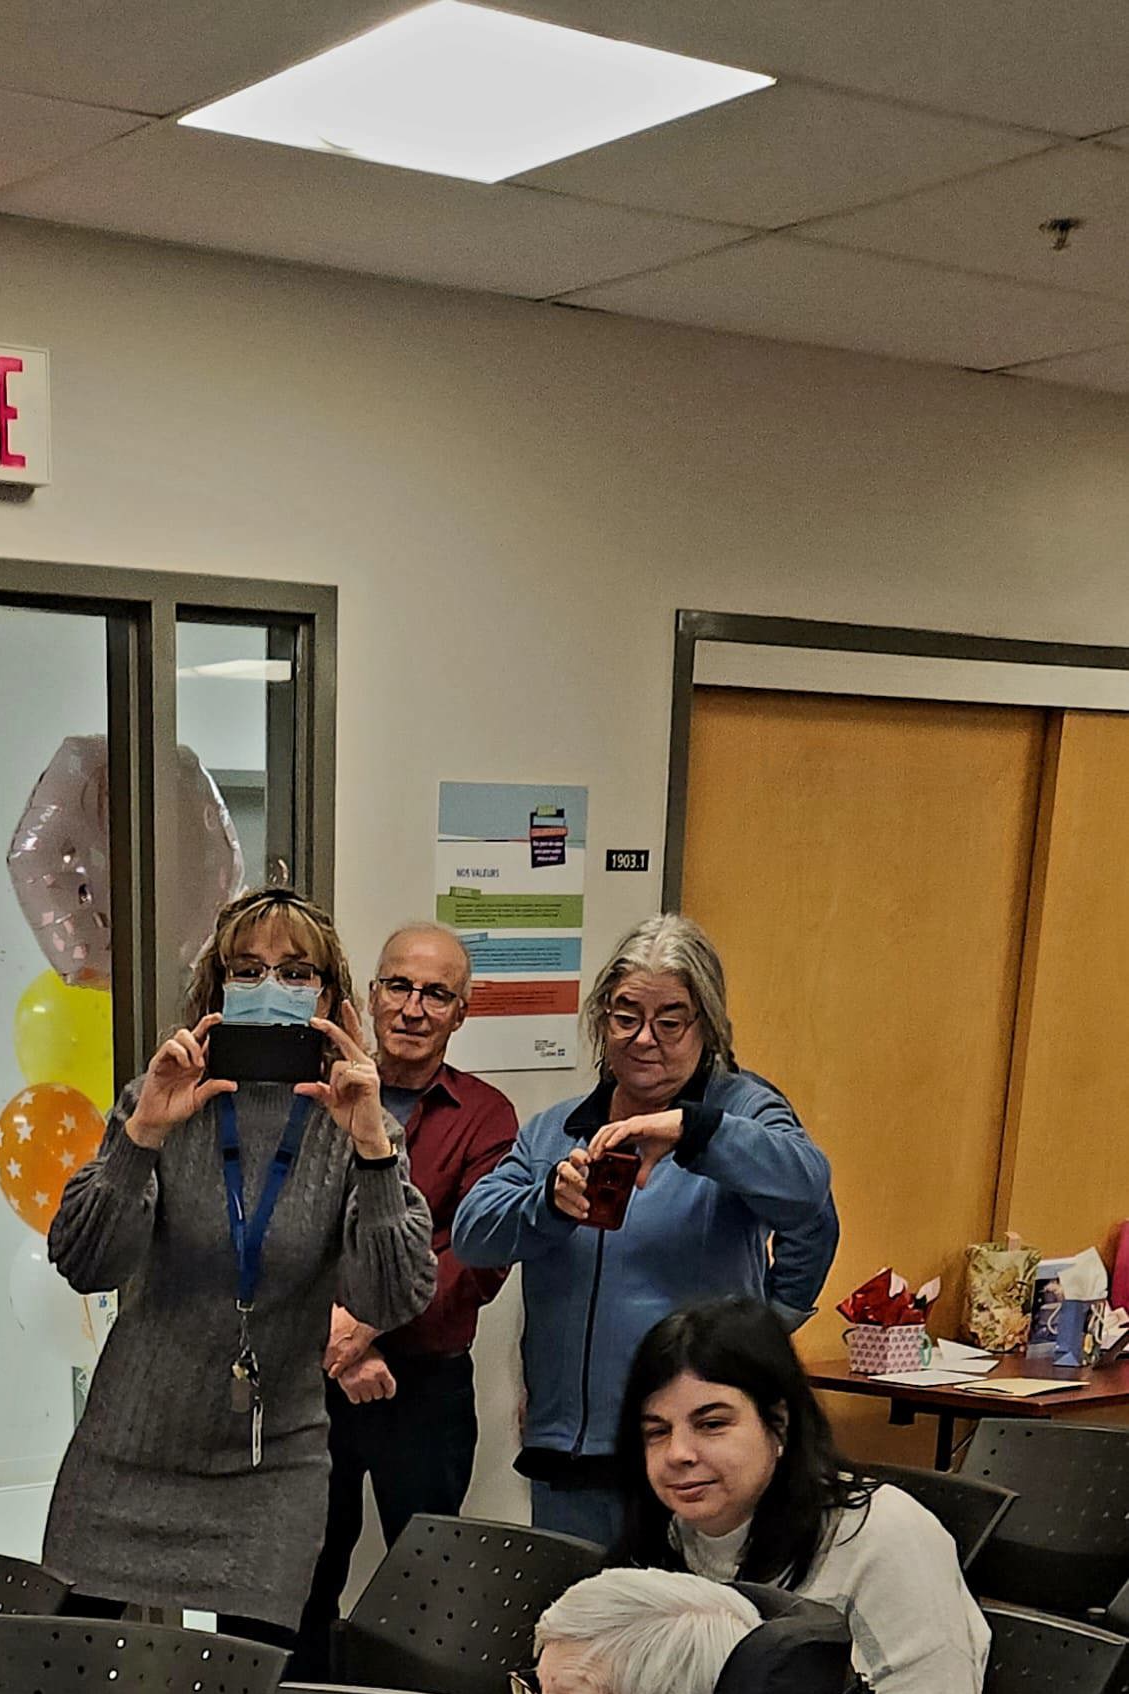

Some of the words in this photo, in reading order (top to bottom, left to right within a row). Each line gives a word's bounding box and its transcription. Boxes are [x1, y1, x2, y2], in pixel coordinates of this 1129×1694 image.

[612, 853, 645, 868] 1903.1
[456, 868, 470, 878] NOS
[471, 868, 500, 878] VALEURS
